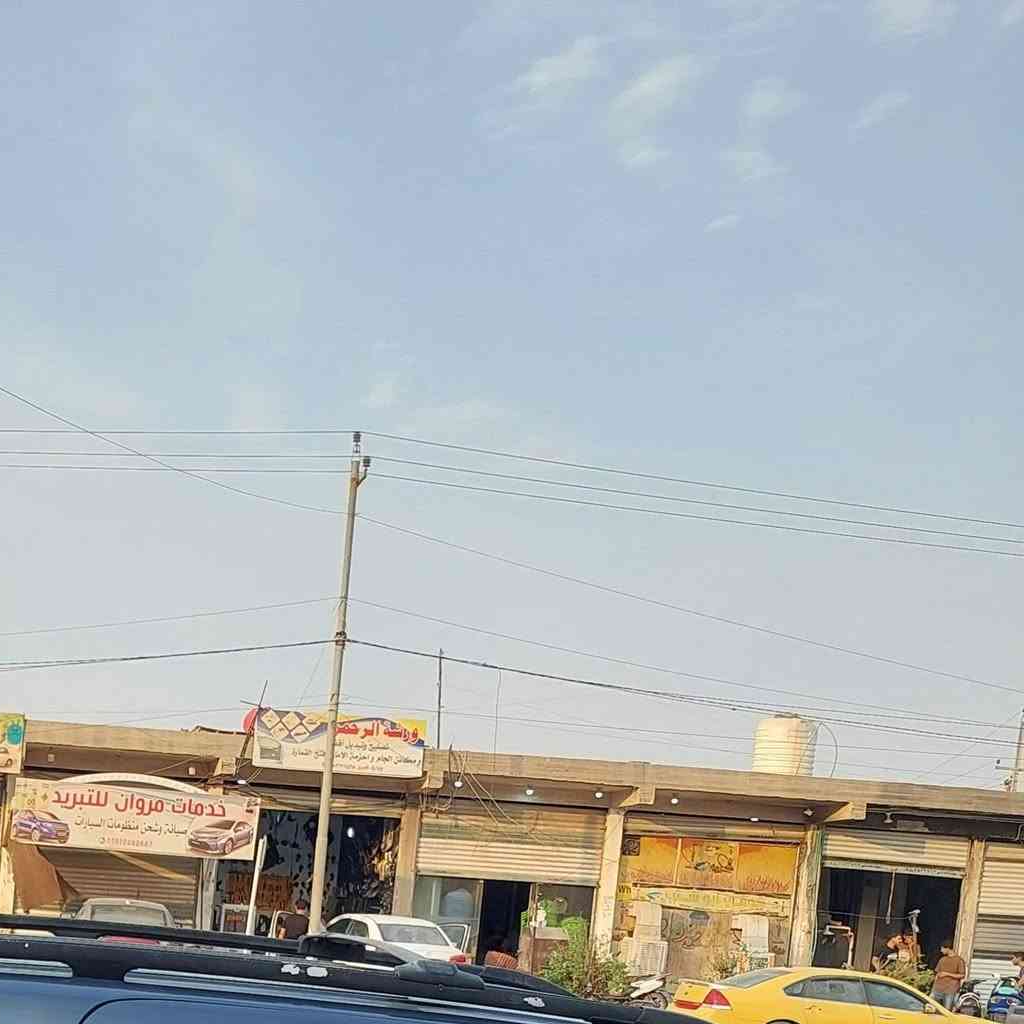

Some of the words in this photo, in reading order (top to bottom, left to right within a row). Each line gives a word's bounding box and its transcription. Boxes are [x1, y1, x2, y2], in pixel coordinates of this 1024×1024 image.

[334, 720, 381, 740] الرحم
[51, 787, 109, 808] للتبريد
[114, 792, 165, 815] مروان
[171, 798, 226, 817] خدمات
